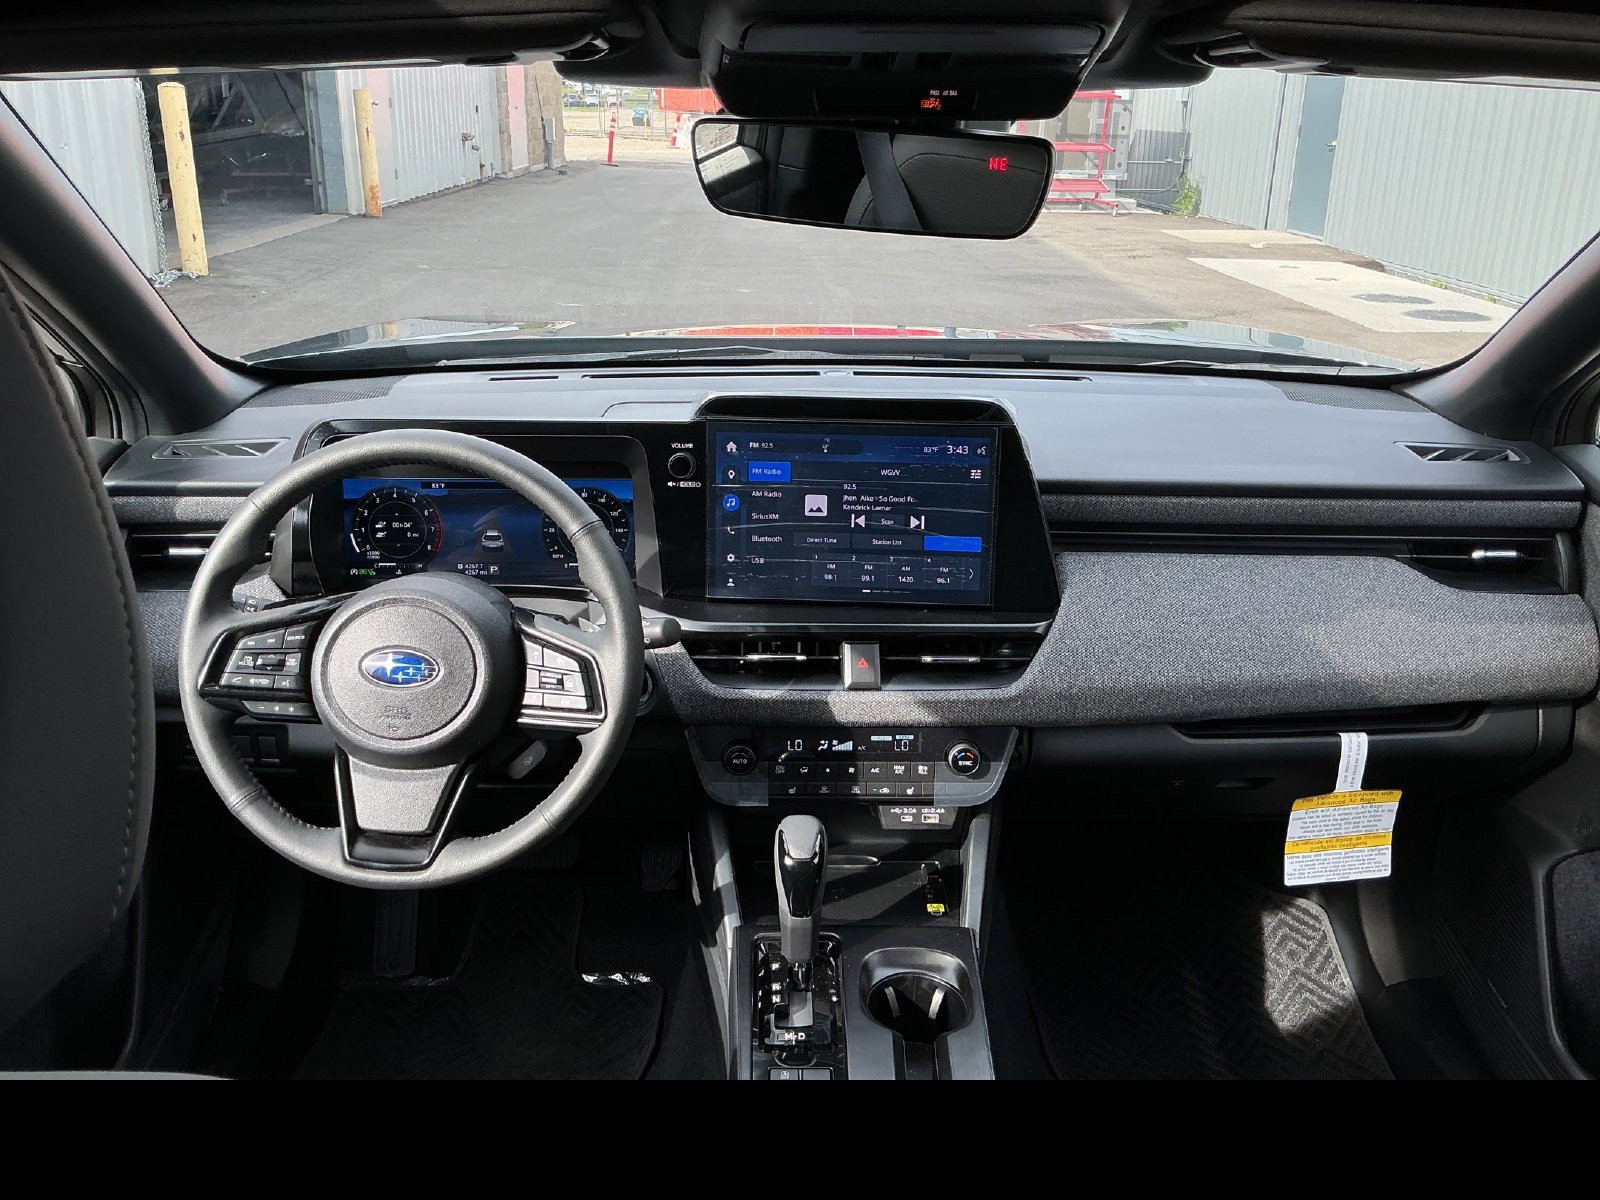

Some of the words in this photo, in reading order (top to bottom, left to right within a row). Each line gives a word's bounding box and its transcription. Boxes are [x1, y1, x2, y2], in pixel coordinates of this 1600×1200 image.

[990, 157, 1008, 171] NE
[946, 445, 969, 454] 3:43
[490, 566, 498, 574] P
[788, 740, 802, 751] LO
[894, 740, 909, 751] LO
[1316, 798, 1346, 806] Advanced
